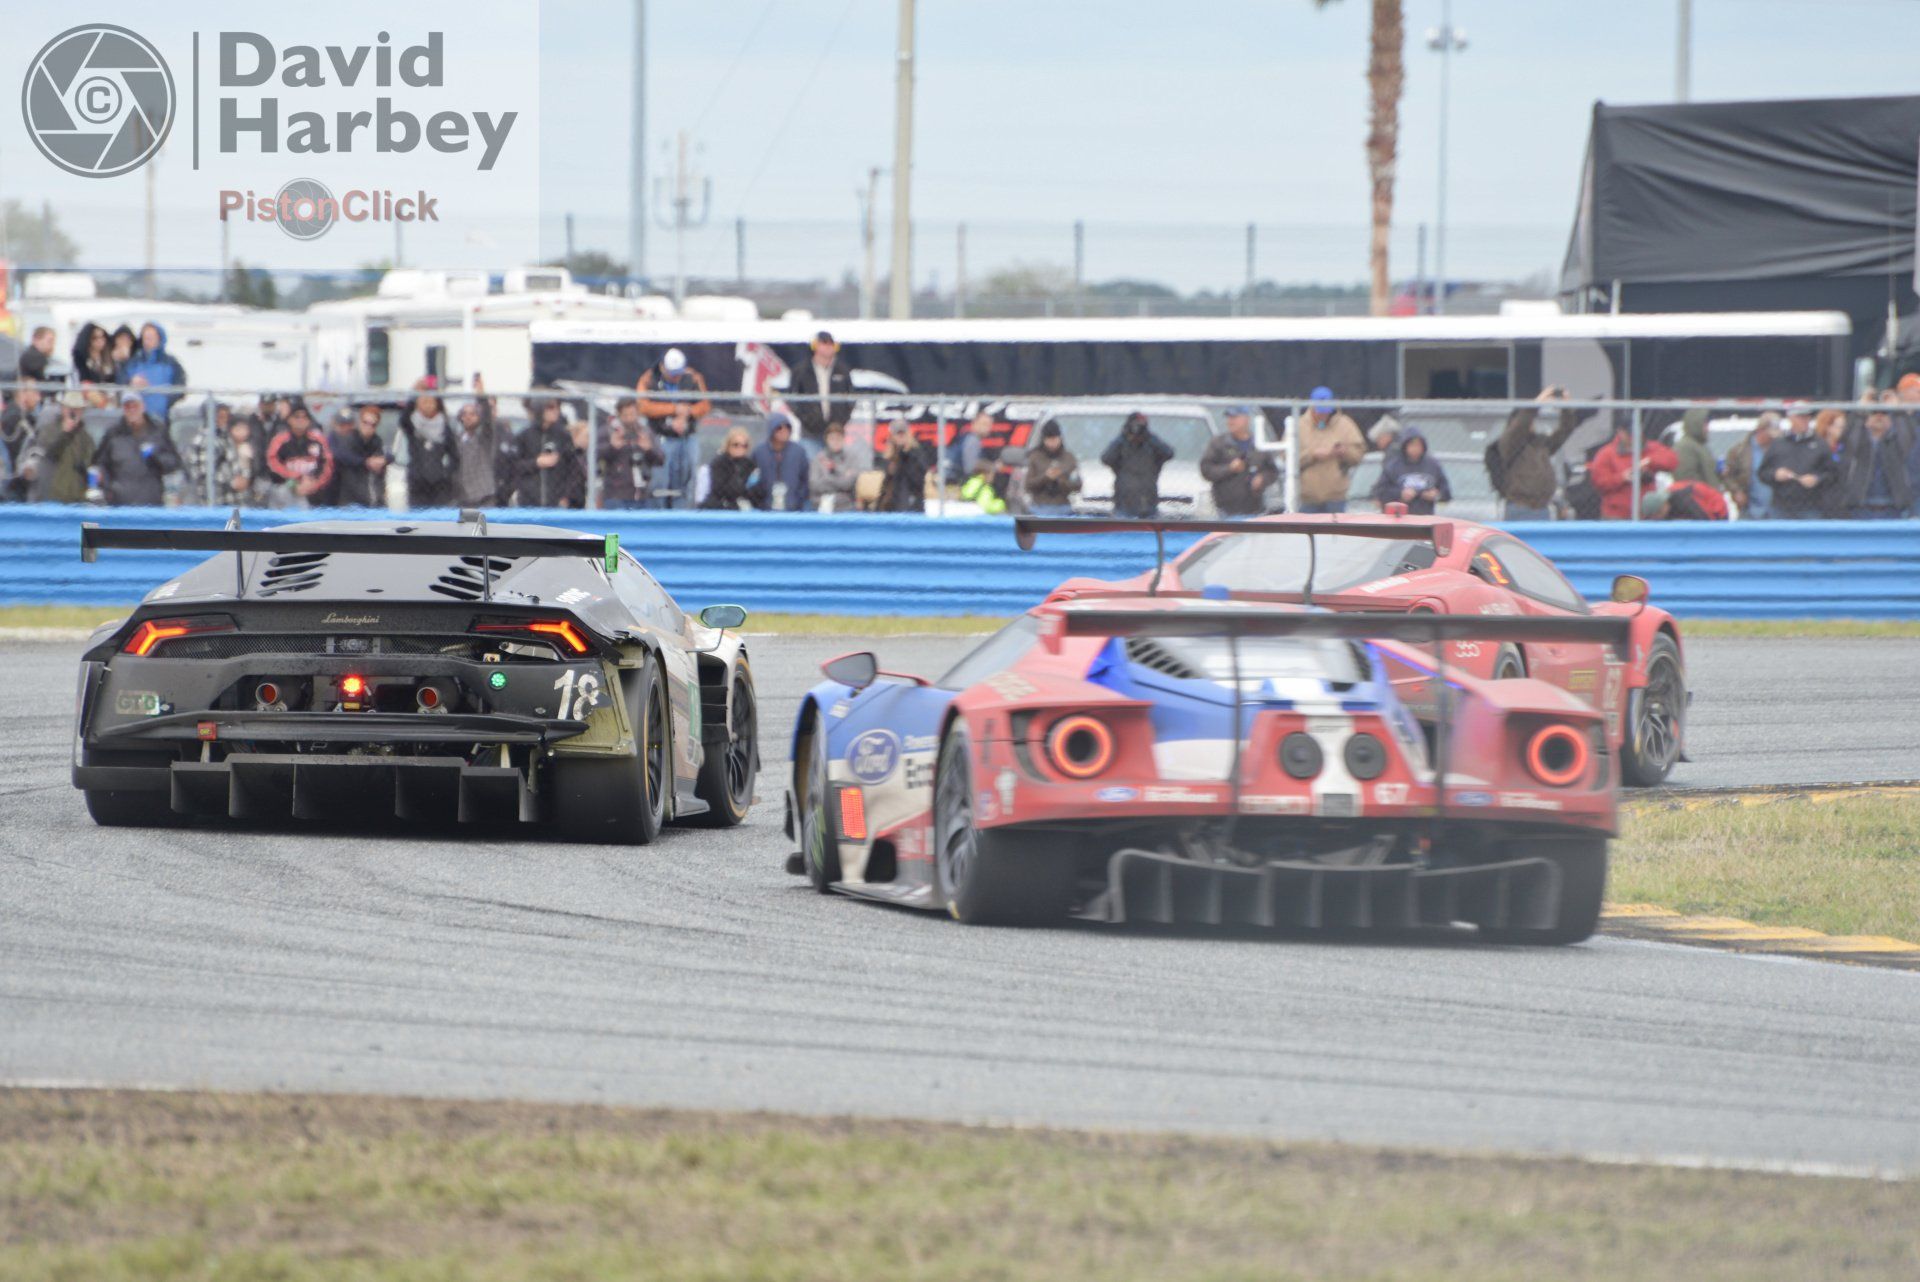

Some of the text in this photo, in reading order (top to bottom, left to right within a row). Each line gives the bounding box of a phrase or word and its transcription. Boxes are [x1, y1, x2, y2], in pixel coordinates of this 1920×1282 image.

[321, 612, 380, 625] Lamborghini
[554, 669, 599, 721] 18
[855, 736, 893, 774] Ford
[1374, 783, 1410, 805] 67
